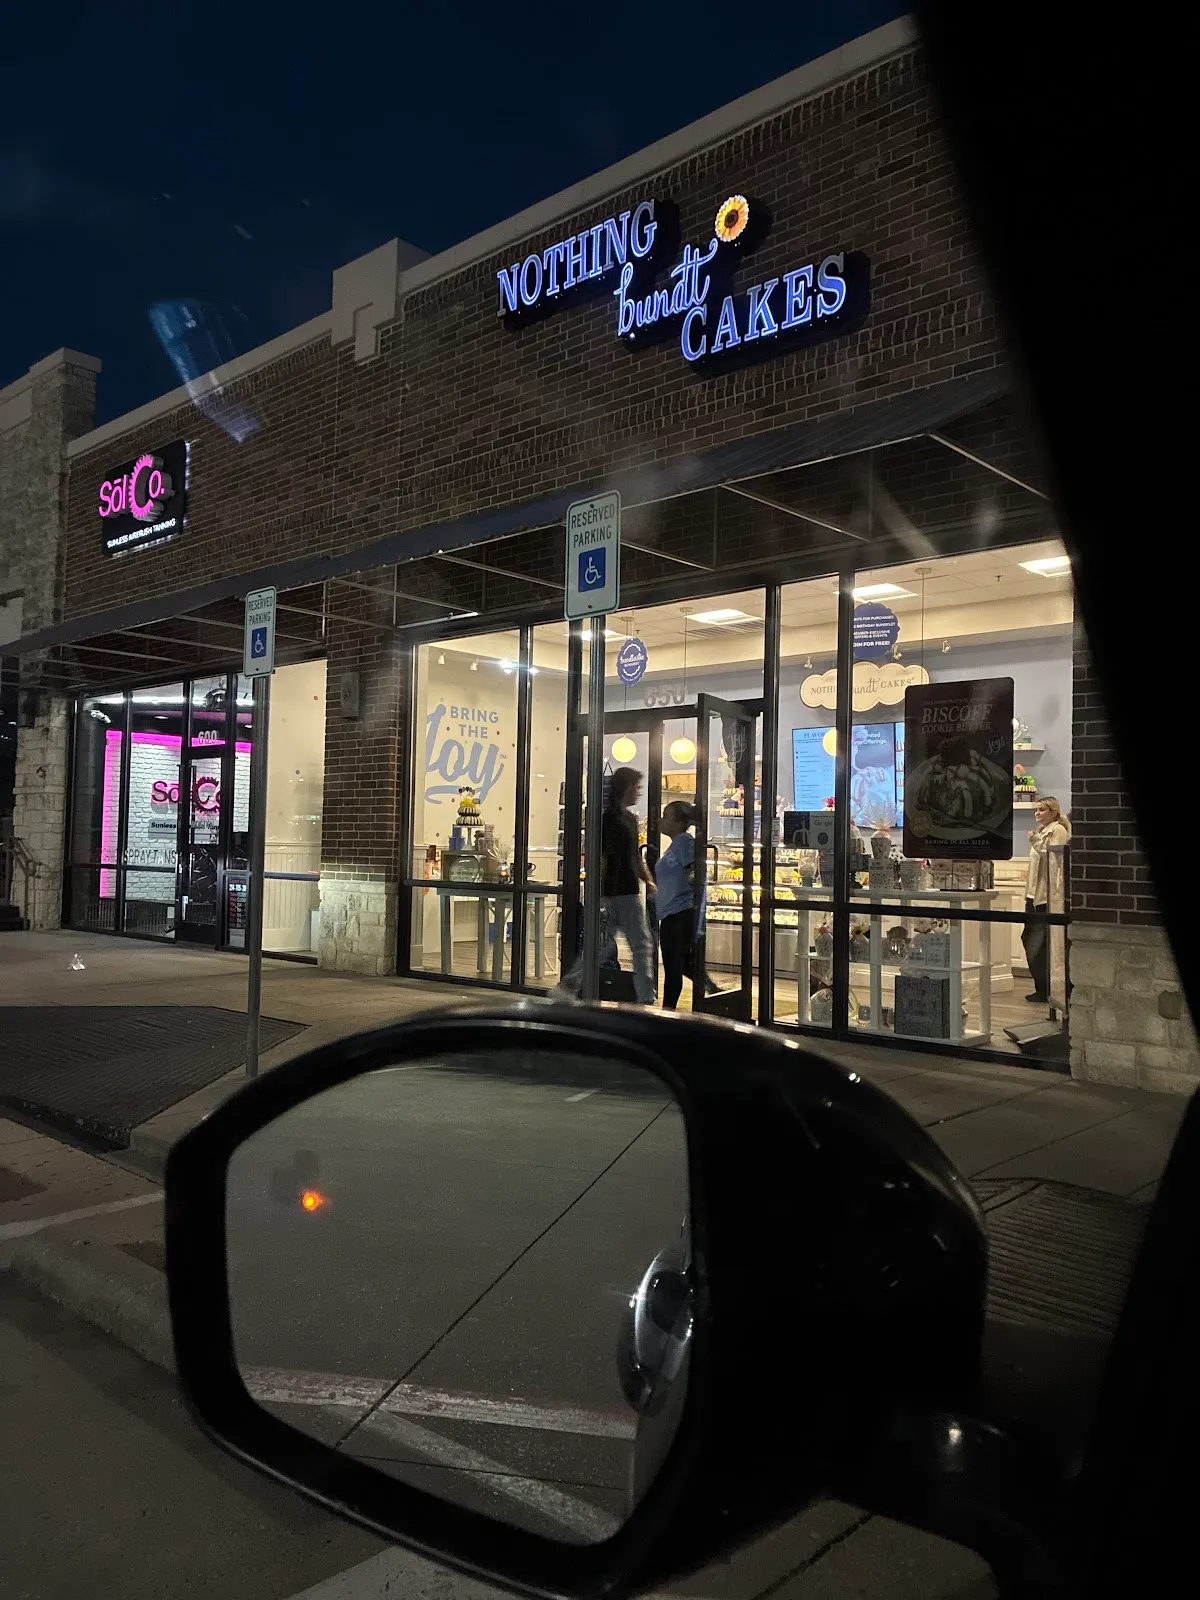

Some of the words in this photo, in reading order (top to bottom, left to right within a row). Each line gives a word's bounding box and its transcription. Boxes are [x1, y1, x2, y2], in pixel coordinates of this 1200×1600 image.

[496, 199, 657, 317] NOTHING
[613, 237, 719, 336] bundt
[680, 251, 847, 361] CAKES
[571, 503, 615, 530] RESERVED
[107, 534, 129, 548] SUNLESS
[152, 517, 176, 532] TANNING
[573, 525, 612, 549] PARKING
[248, 596, 273, 611] RESERVED
[248, 611, 271, 625] PARKING
[644, 684, 686, 707] 650
[810, 685, 836, 695] NOTHI
[853, 677, 879, 694] undt
[450, 705, 499, 724] BRING
[922, 704, 992, 724] BISCOFF
[198, 729, 217, 745] 600
[458, 724, 488, 739] THE
[921, 723, 955, 734] COOKIE
[956, 721, 992, 733] BUTTER
